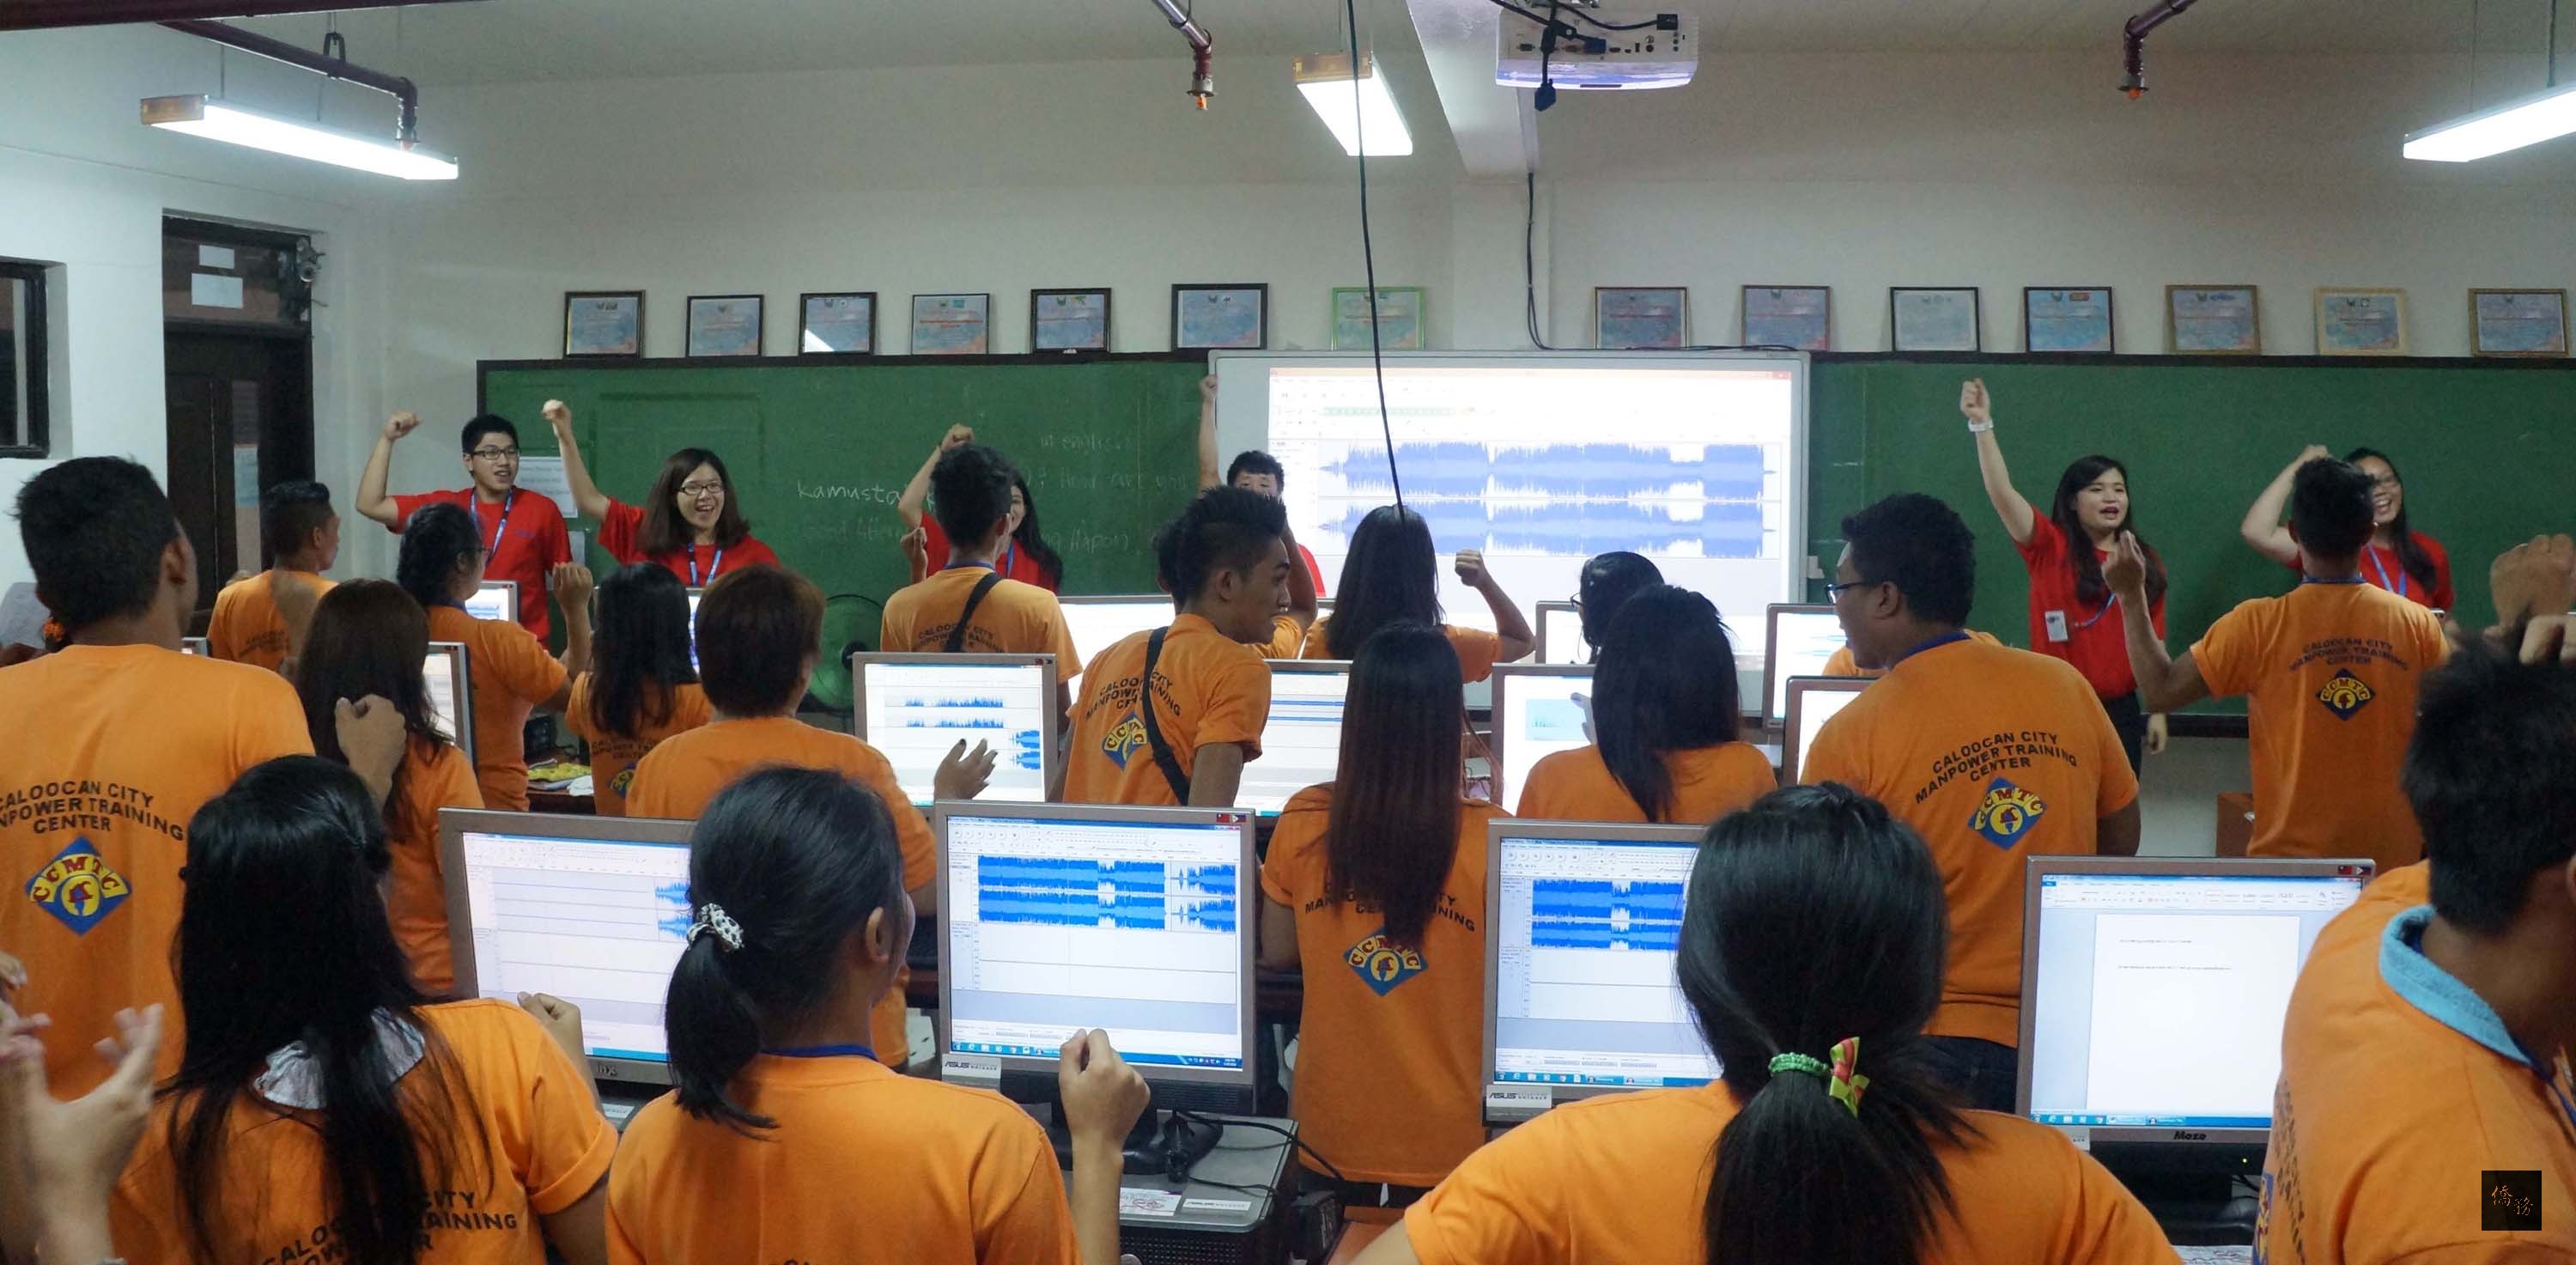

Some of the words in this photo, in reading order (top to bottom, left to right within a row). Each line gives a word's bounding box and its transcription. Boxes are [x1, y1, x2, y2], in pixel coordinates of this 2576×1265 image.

[797, 479, 900, 506] kamusta
[1099, 677, 1143, 696] CALOO
[1085, 687, 1142, 720] MANPOW
[1106, 721, 1144, 749] CCTC
[1932, 733, 2015, 774] CALOOCAN
[2020, 731, 2058, 745] CITY
[1914, 747, 2000, 804] MANPOWER
[2004, 745, 2078, 767] TRAINING
[1969, 757, 2032, 782] CENTER
[107, 782, 155, 807] CITY
[0, 798, 82, 828] NPOWER
[89, 797, 185, 841] TRAINING
[33, 814, 112, 835] CENTER
[32, 854, 121, 903] CCMTC
[420, 1211, 518, 1231] AINING
